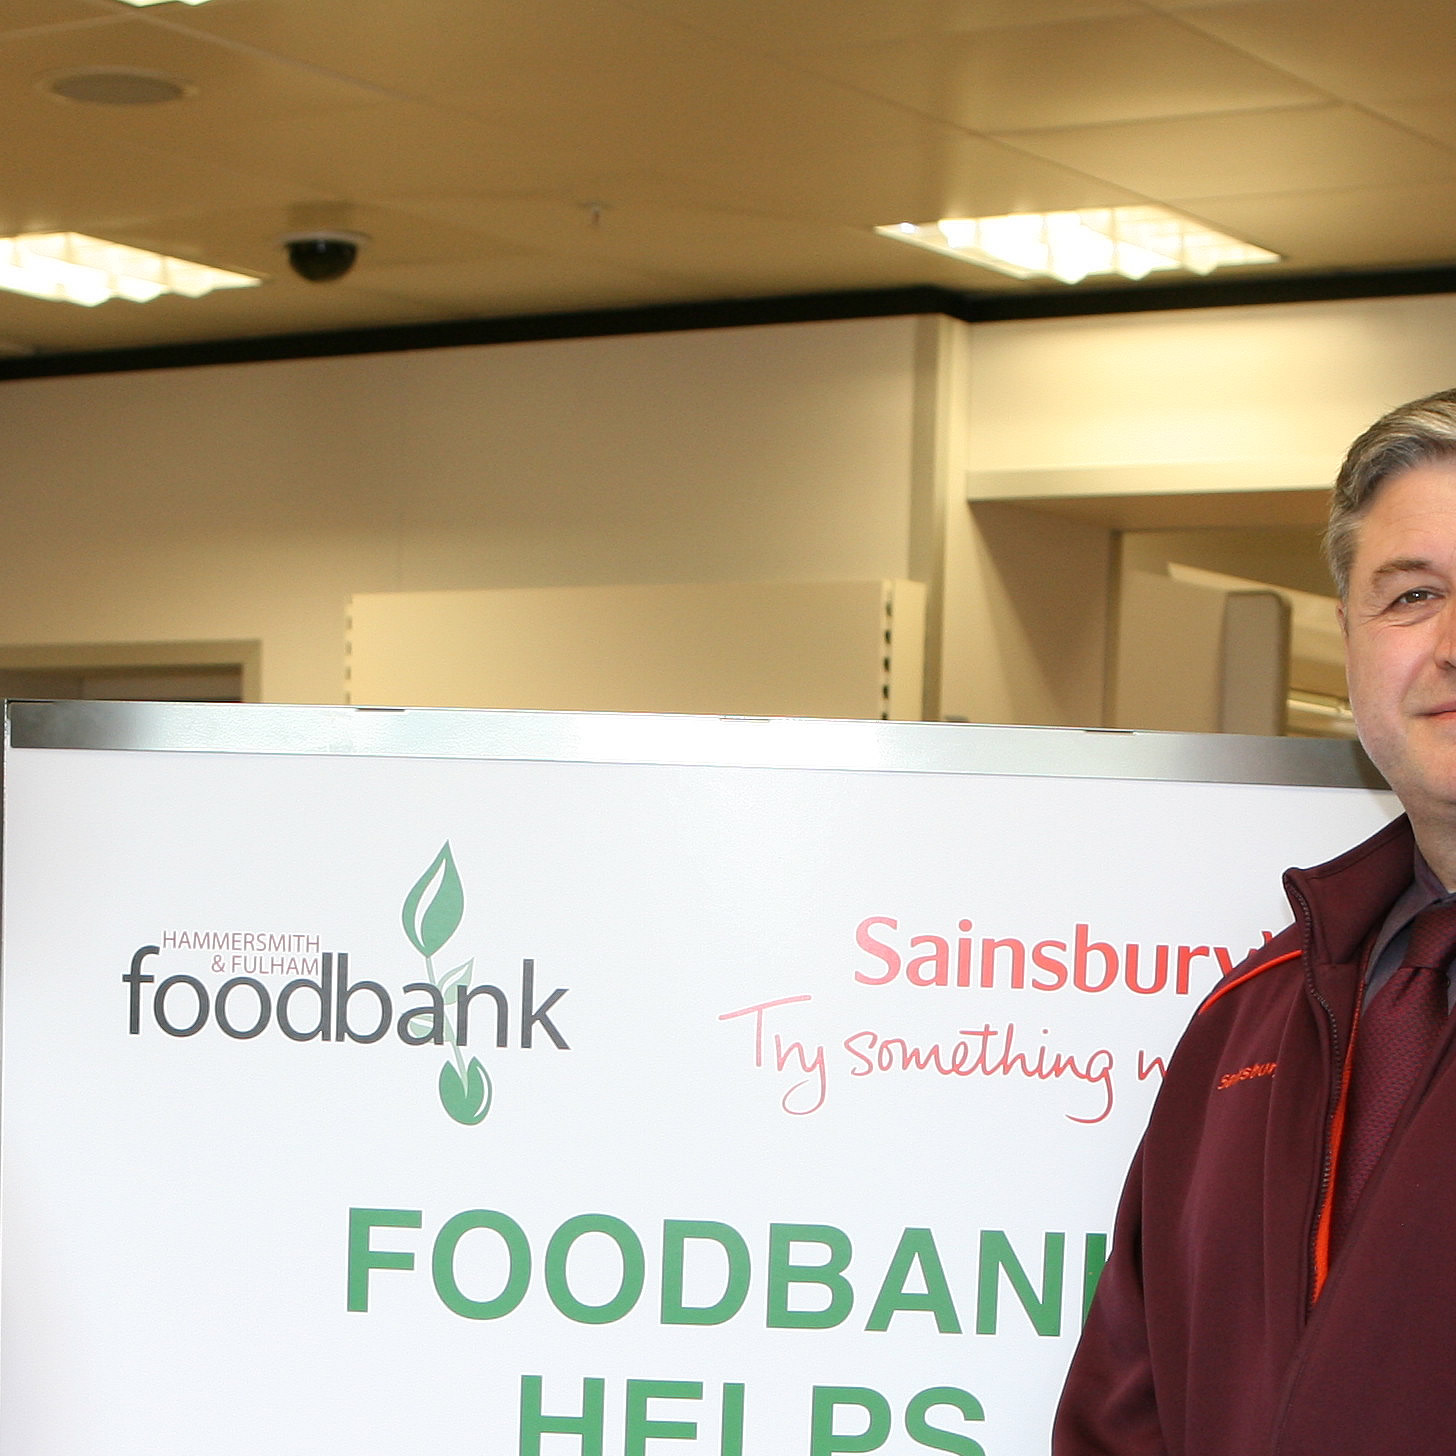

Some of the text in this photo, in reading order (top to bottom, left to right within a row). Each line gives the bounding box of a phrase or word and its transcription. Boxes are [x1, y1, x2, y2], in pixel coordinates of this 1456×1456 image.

[162, 930, 320, 954] HAMMERSMITH
[210, 954, 319, 975] & FULHAM
[122, 945, 571, 1050] foodbank
[719, 994, 1114, 1123] Try something
